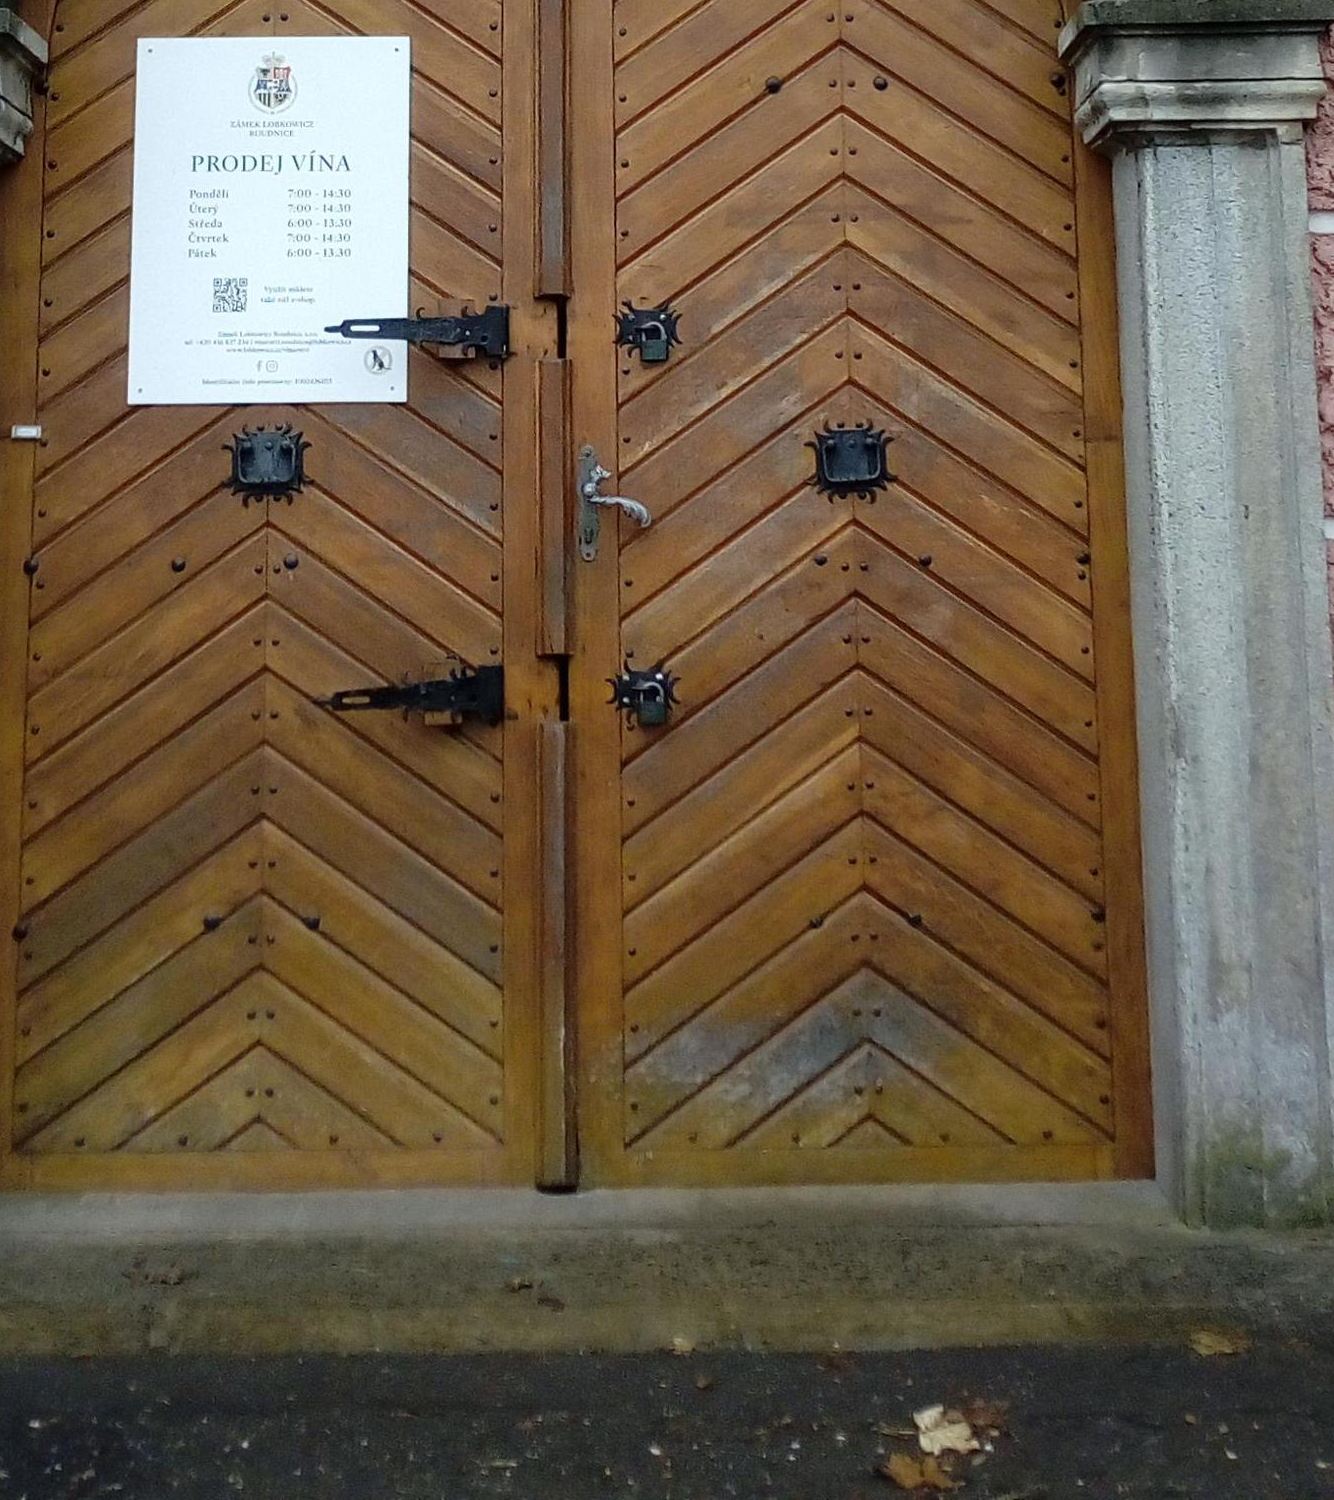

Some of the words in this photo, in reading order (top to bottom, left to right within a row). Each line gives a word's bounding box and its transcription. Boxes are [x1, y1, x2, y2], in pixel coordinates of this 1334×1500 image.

[190, 154, 284, 176] PRODEJ
[291, 149, 351, 173] VÍNA
[287, 188, 312, 199] 7:00
[323, 188, 352, 199] 14:30
[287, 203, 312, 213] 7:00
[323, 203, 351, 213] 14:30
[188, 218, 223, 228] Středa
[287, 218, 313, 228] 6:00
[323, 218, 352, 228] 13:30
[188, 231, 229, 243] Čtvrtek
[287, 233, 311, 243] 7:00
[322, 233, 351, 243] 14:30
[188, 247, 217, 258] Pátek
[287, 248, 312, 258] 6:00
[323, 247, 352, 258] 13:30
